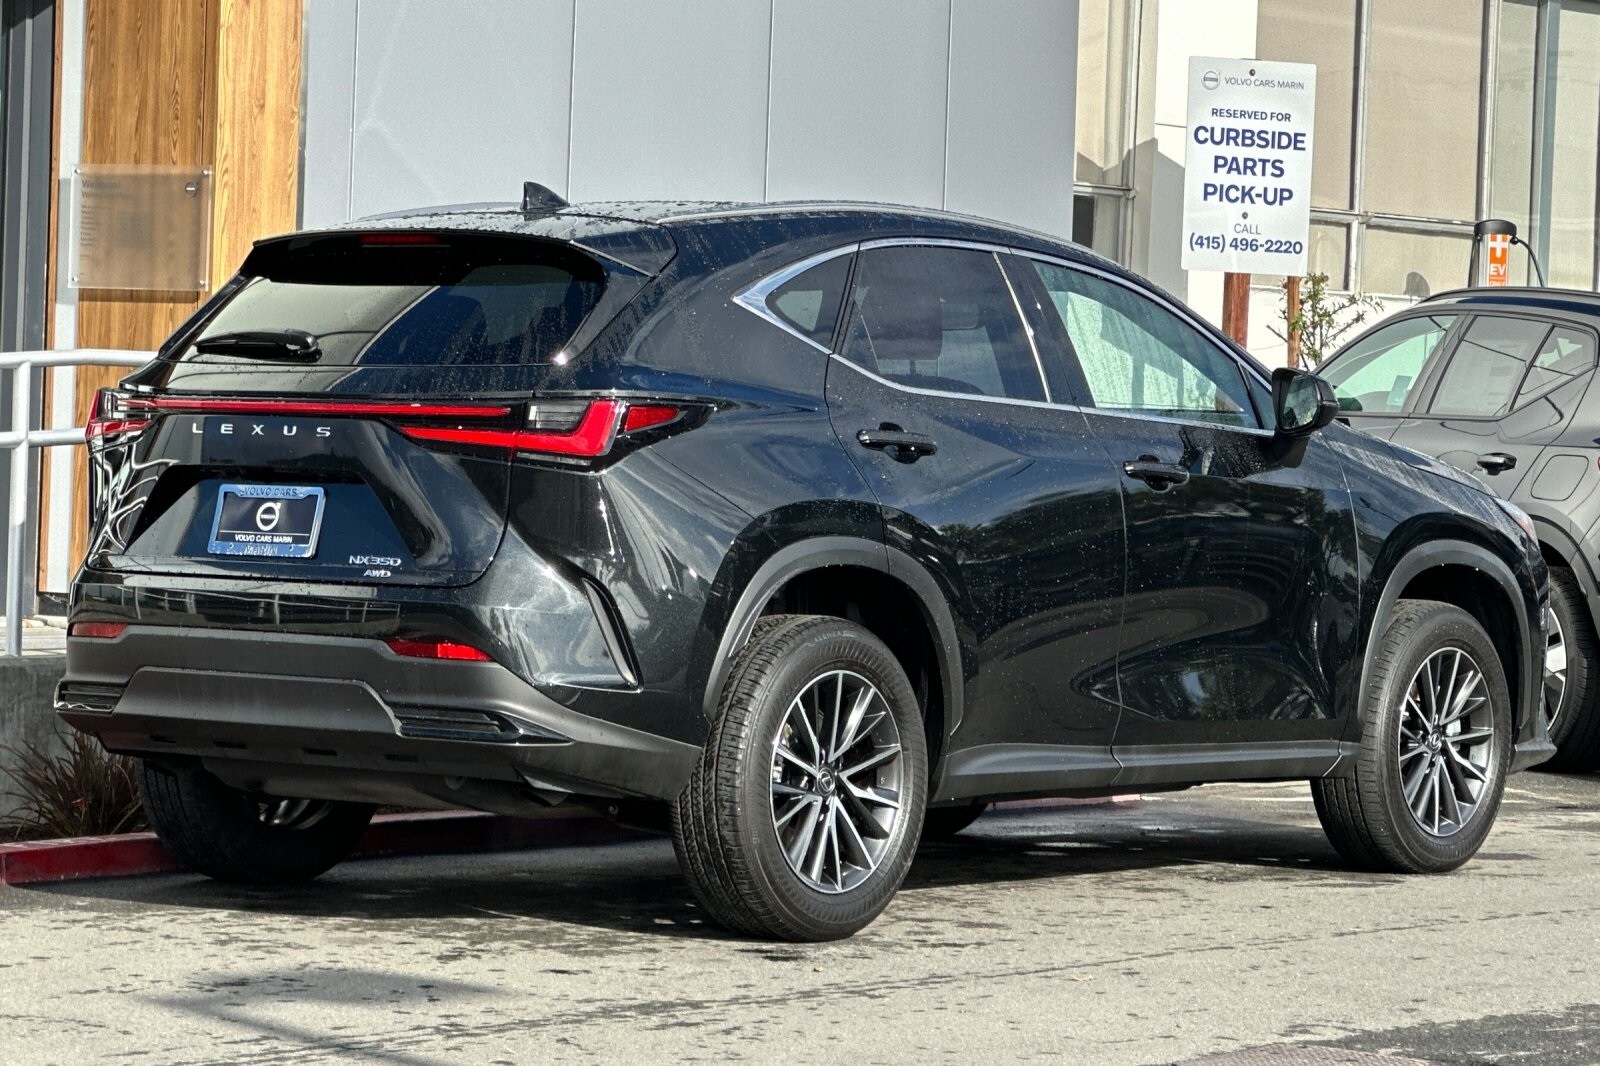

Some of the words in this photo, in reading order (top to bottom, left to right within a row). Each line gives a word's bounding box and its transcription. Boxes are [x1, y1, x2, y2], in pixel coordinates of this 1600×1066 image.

[1224, 77, 1253, 87] VOLVO
[1253, 79, 1276, 88] CARS
[1277, 80, 1305, 90] MARIN
[1211, 108, 1268, 121] RESERVED
[1270, 111, 1291, 122] FOR
[1193, 126, 1306, 151] CURBSIDE
[1213, 155, 1285, 178] PARTS
[1203, 183, 1294, 206] PICK-UP
[1234, 223, 1261, 235] CALL
[1189, 232, 1226, 253] (415)
[1229, 238, 1303, 254] 496-2220
[1490, 264, 1506, 276] EV
[191, 422, 332, 438] LEXUS
[244, 486, 272, 497] VOLVO
[273, 487, 298, 497] CARS
[234, 533, 255, 542] VOLVO
[256, 535, 273, 543] CARS
[273, 535, 293, 543] MARIN
[363, 568, 392, 578] AWD
